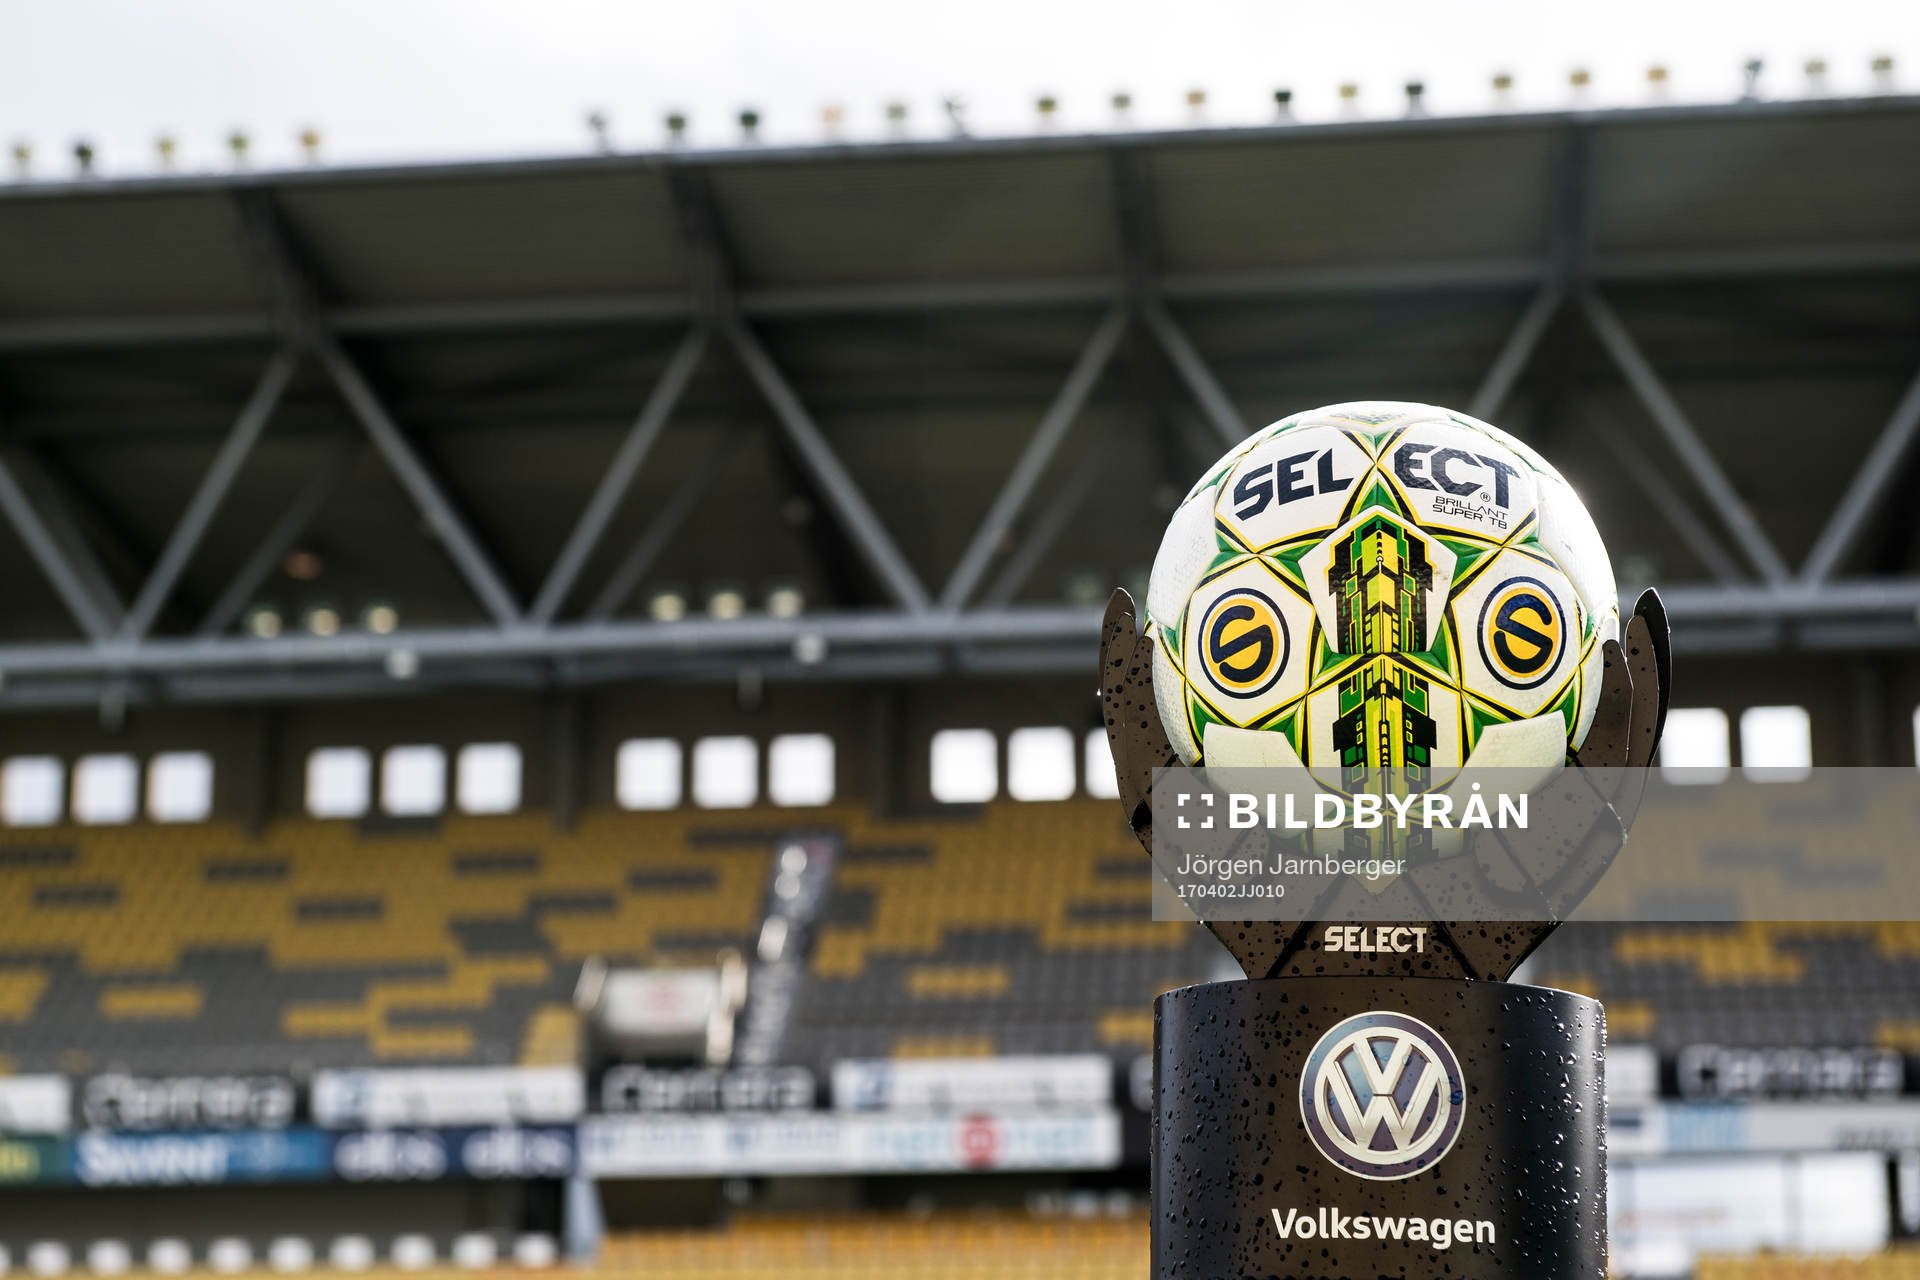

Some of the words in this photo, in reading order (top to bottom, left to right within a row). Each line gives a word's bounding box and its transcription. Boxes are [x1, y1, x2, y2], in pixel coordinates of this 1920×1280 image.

[1432, 504, 1483, 522] SUPER
[1491, 517, 1508, 530] TB
[1435, 496, 1508, 520] BRILLANT
[1324, 926, 1427, 953] SELECT
[1272, 1208, 1495, 1250] Volkswagen
